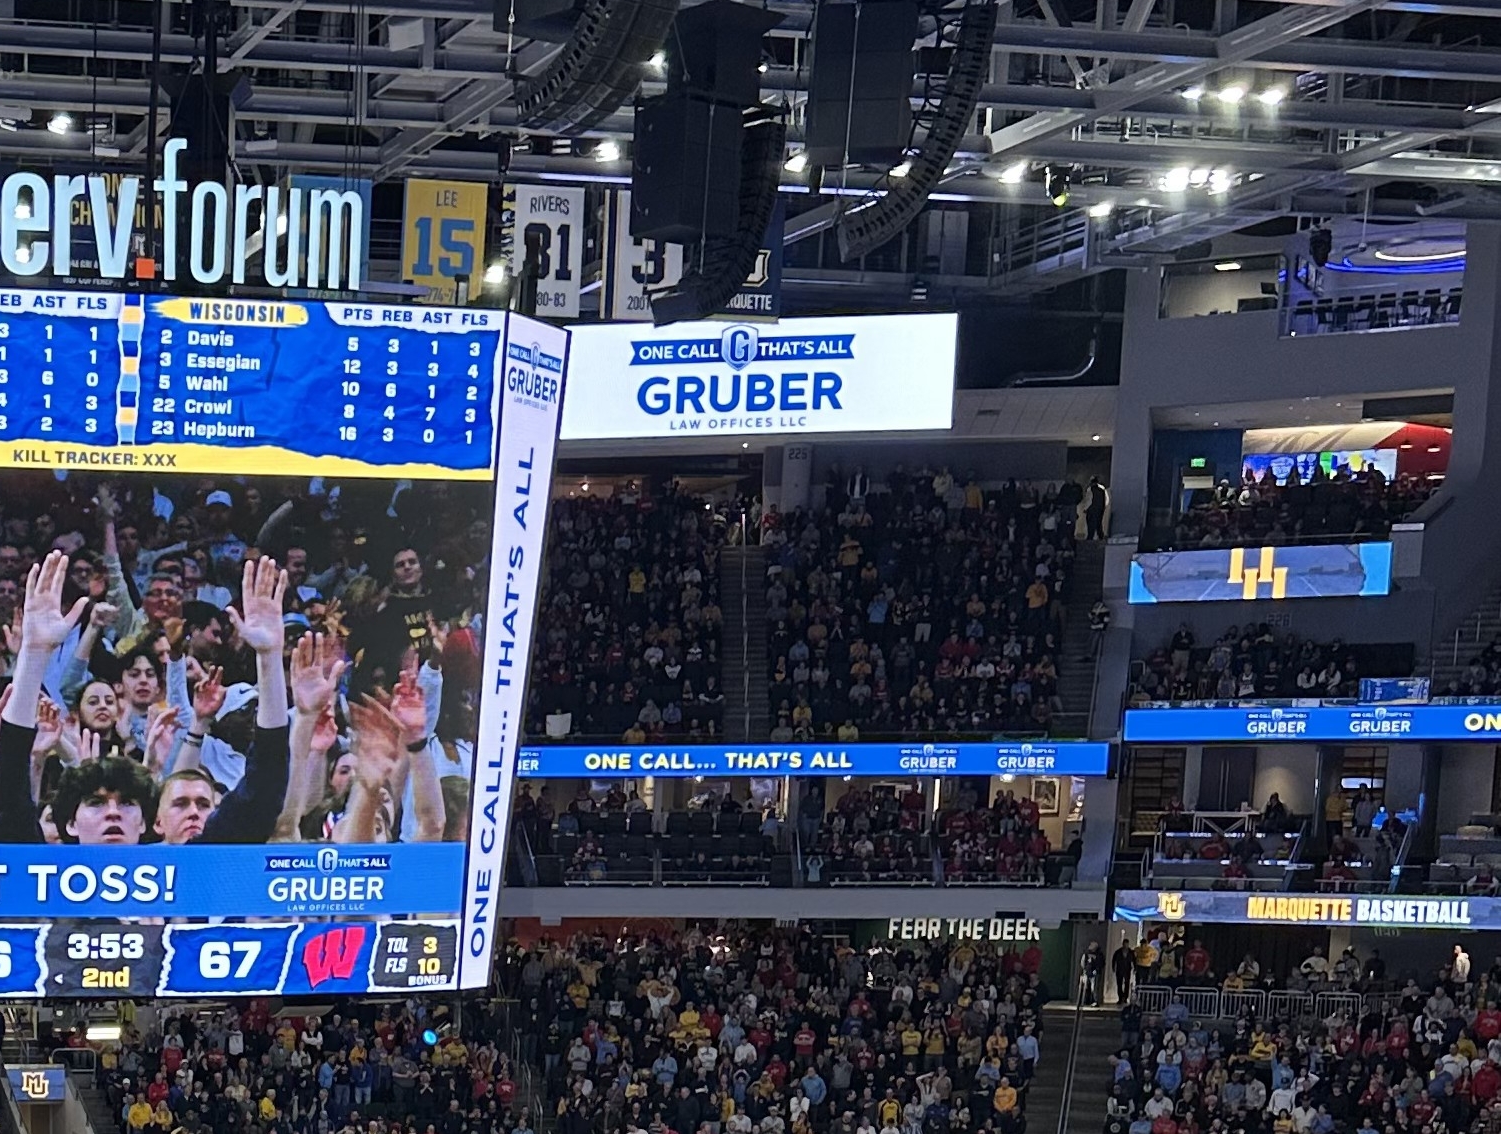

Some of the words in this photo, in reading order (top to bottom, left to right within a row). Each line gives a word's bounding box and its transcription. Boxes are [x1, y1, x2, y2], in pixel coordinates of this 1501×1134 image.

[436, 190, 459, 208] LEE
[529, 196, 571, 215] RIVERS
[412, 217, 474, 277] 15
[33, 295, 66, 308] AST
[77, 297, 107, 310] FLS
[190, 303, 285, 323] WISCONSIN
[344, 308, 373, 321] PTS
[383, 310, 413, 322] REB
[423, 312, 452, 324] AST
[462, 314, 488, 325] FLS
[160, 330, 173, 344] 2
[188, 330, 234, 346] Davis
[639, 345, 674, 360] ONE
[677, 343, 720, 359] CALL
[758, 341, 814, 357] THAT'S
[818, 340, 847, 355] ALL
[160, 352, 171, 367] 3
[187, 353, 260, 372] Essegian
[159, 375, 170, 390] 5
[186, 376, 228, 391] Wahl
[508, 367, 558, 404] GRUBER
[637, 371, 843, 416] GRUBER
[153, 398, 175, 413] 22
[185, 399, 232, 415] Crowl
[152, 421, 174, 435] 23
[184, 421, 255, 439] Hepburn
[670, 419, 701, 430] LAW
[708, 417, 774, 430] OFFICES
[780, 416, 807, 429] LLC
[13, 450, 50, 463] KILL
[55, 451, 138, 466] TRACKER:
[143, 454, 177, 467] XXX
[470, 869, 491, 957] ONE
[496, 545, 525, 692] THAT'S
[513, 446, 534, 529] ALL
[1247, 721, 1305, 734] GRUBER
[584, 752, 631, 770] ONE
[639, 752, 716, 770] CALL...
[725, 752, 802, 769] THAT'S
[810, 752, 853, 768] ALL
[899, 756, 957, 769] GRUBER
[270, 858, 291, 868] ONE
[292, 859, 316, 868] CALL
[338, 858, 370, 868] THAT'S
[370, 858, 387, 868] ALL
[27, 864, 175, 902] TOSS!
[268, 876, 384, 901] GRUBER
[287, 904, 305, 912] LAW
[349, 903, 365, 911] LLC
[1247, 896, 1352, 922] MARQUETTE
[1356, 898, 1471, 924] BASKETBALL
[888, 918, 941, 940] FEAR
[946, 918, 985, 941] THE
[988, 918, 1041, 941] DEER
[67, 933, 144, 960] 3:53
[387, 937, 409, 953] TOL
[423, 936, 438, 954] 3
[199, 941, 261, 979] 67
[303, 926, 366, 990] W
[385, 957, 407, 973] FLS
[417, 957, 441, 975] 10
[82, 966, 130, 988] 2nd
[408, 974, 447, 986] BONUS
[22, 1072, 49, 1098] MU
